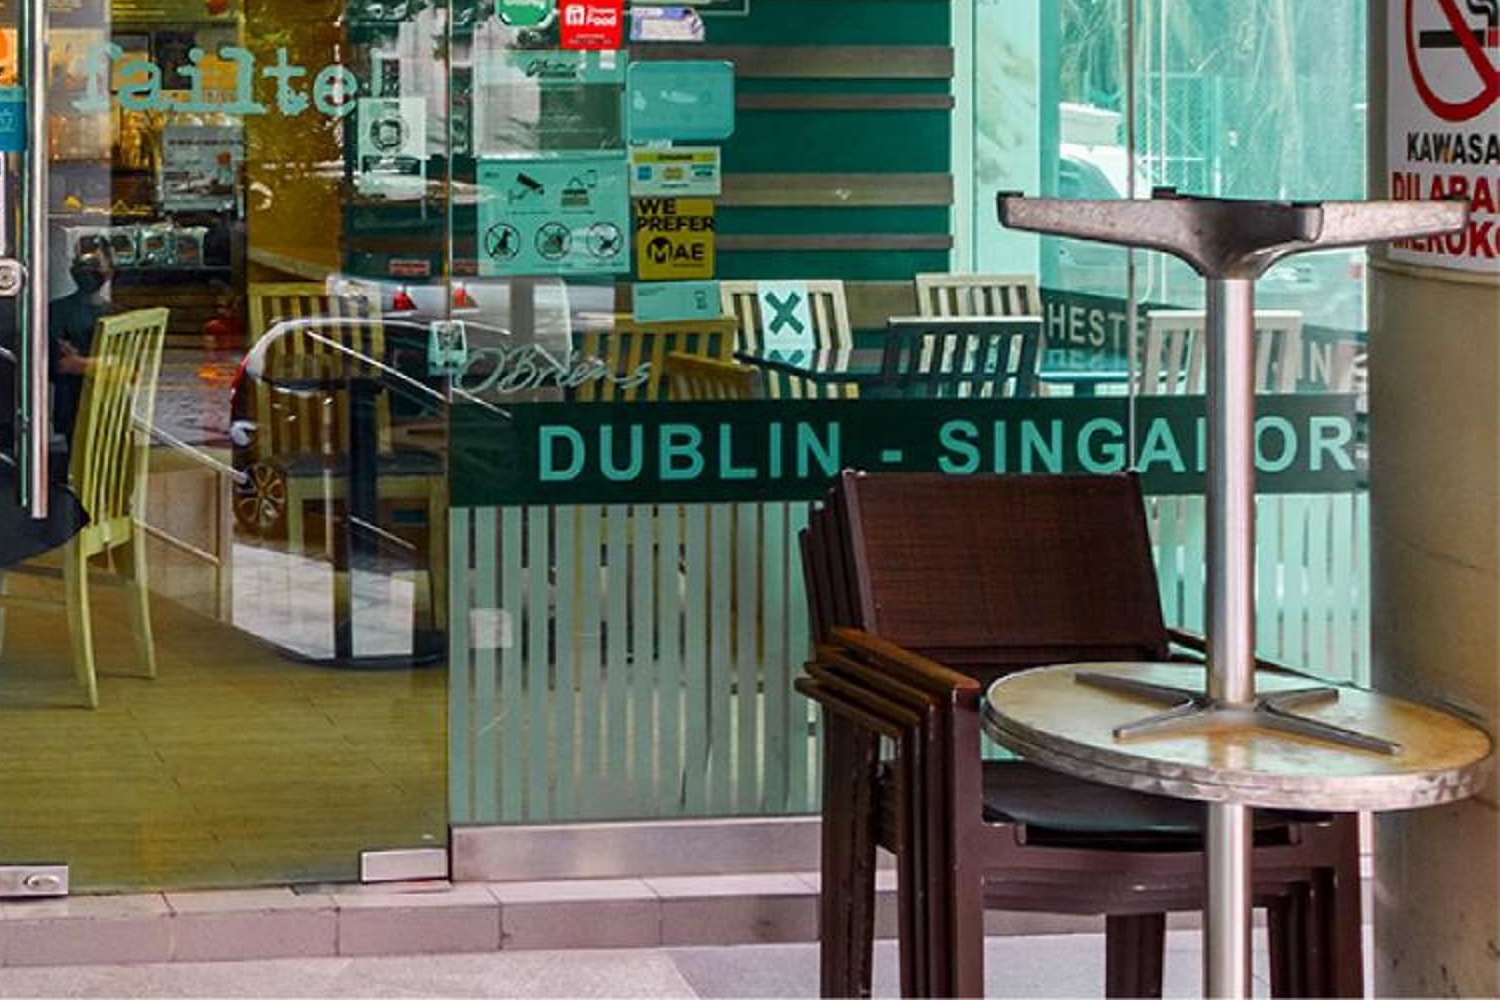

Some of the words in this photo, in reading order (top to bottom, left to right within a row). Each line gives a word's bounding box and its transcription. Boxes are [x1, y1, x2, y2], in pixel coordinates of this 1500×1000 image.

[1407, 132, 1500, 164] KAWASA
[638, 198, 676, 215] WE
[637, 216, 715, 232] PREFER
[539, 422, 841, 481] DUBLIN
